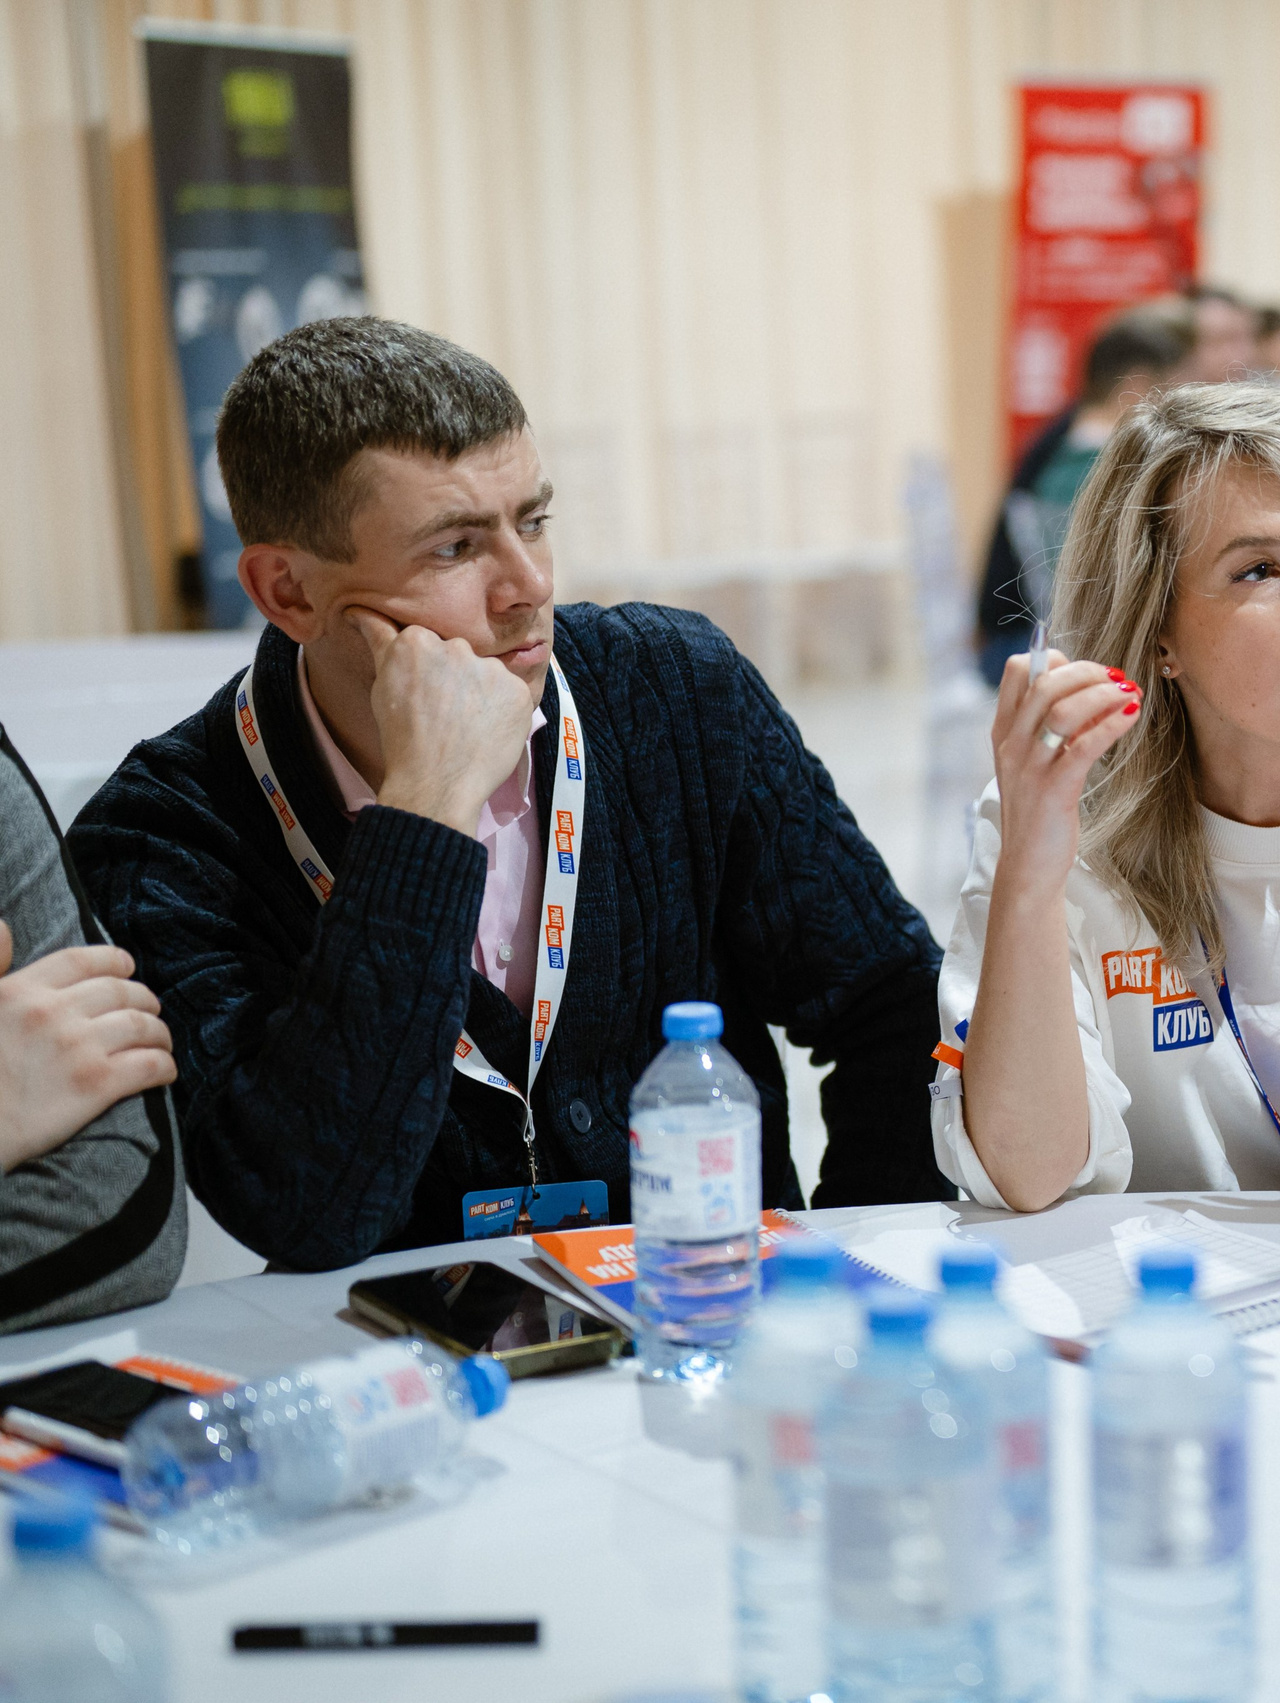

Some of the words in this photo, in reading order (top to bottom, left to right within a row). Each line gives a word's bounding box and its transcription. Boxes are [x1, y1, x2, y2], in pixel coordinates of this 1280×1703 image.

[565, 718, 576, 740] PART
[565, 738, 577, 757] KOM
[568, 758, 581, 780] КЛУБ
[559, 812, 572, 832] PART
[558, 832, 571, 851] KOM
[560, 852, 573, 874] КЛУБ
[550, 906, 562, 927] PART
[547, 926, 560, 946] KOM
[550, 947, 563, 968] КЛУБ
[1106, 952, 1157, 991] PART
[1160, 963, 1193, 998] KO
[539, 1001, 550, 1023] PART
[1157, 1005, 1211, 1046] КЛУБ
[470, 1203, 485, 1216] PART
